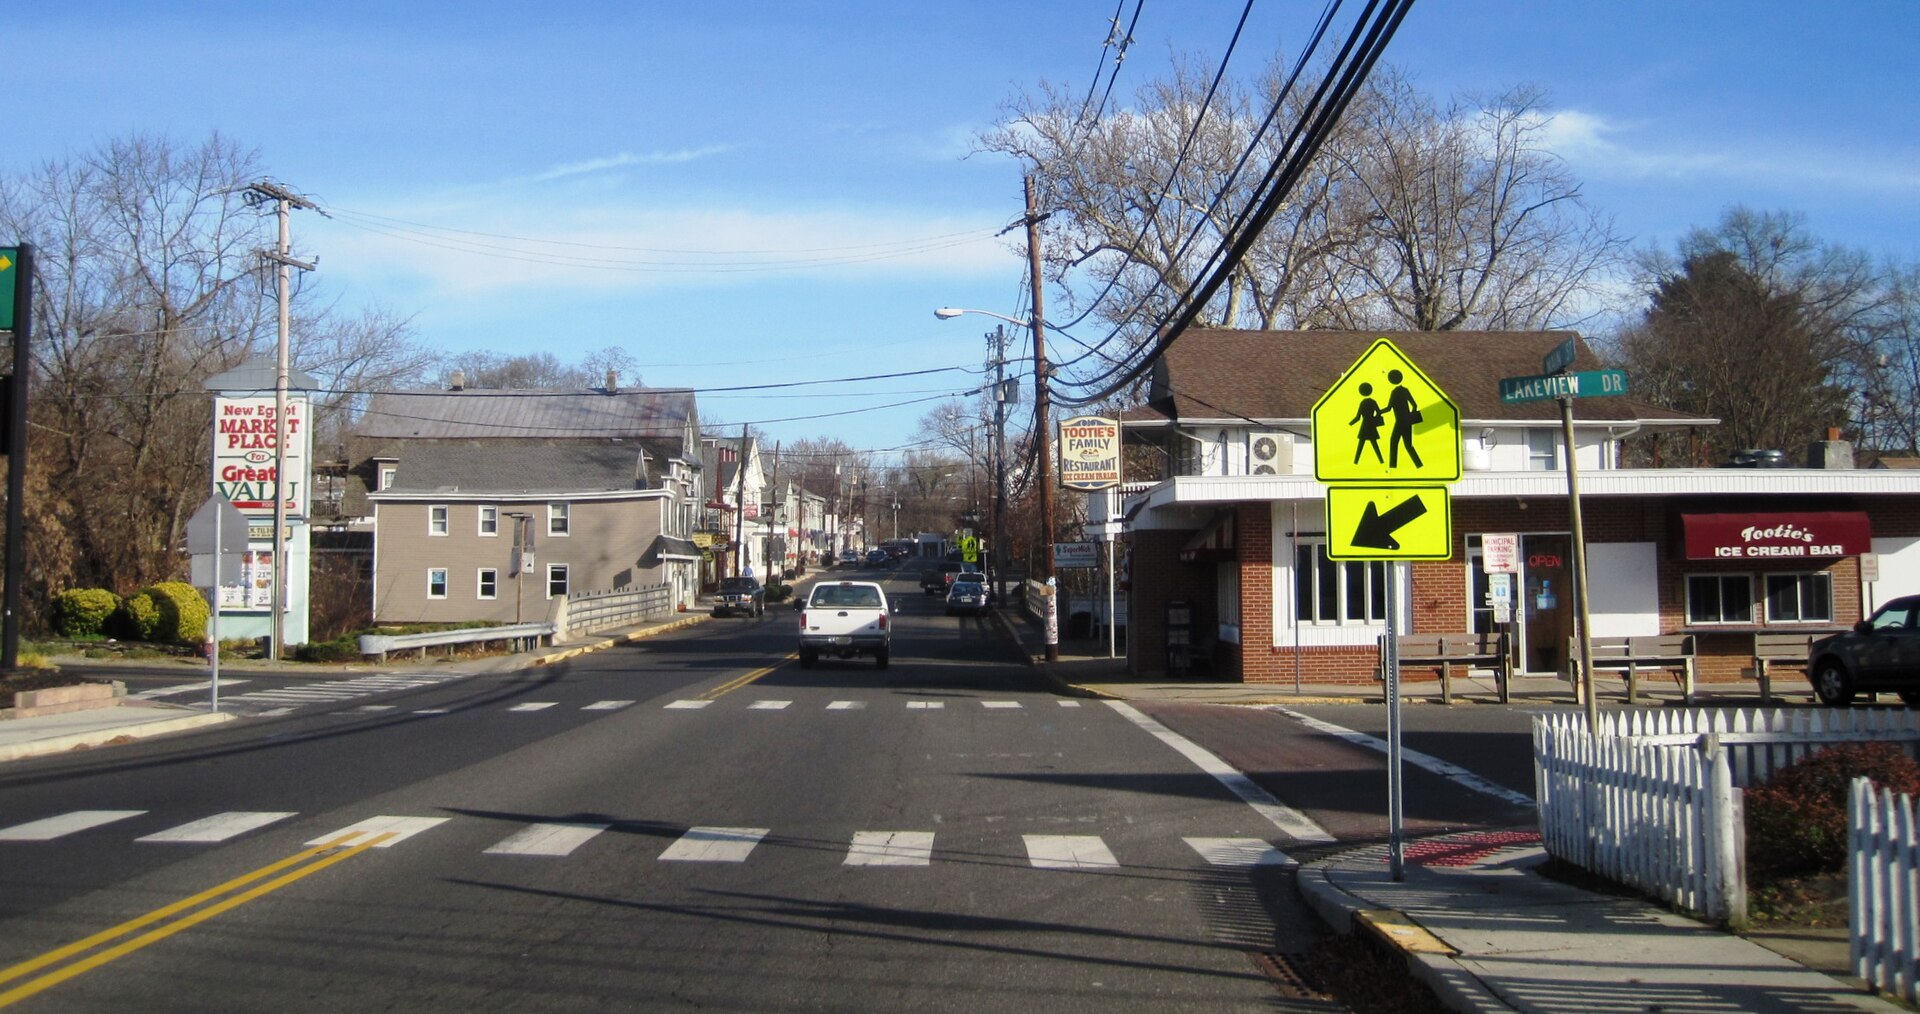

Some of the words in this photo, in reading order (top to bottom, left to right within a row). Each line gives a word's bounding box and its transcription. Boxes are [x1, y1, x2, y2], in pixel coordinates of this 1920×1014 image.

[1505, 376, 1579, 400] LAKEVIEW
[1602, 374, 1623, 392] DR
[224, 405, 254, 416] New
[219, 419, 300, 433] MARKT
[1062, 426, 1115, 438] TOOTIE'S
[228, 434, 290, 449] PLAC
[1069, 438, 1110, 451] FAMILY
[251, 453, 265, 461] For
[1063, 457, 1117, 472] RESTAURANT
[222, 465, 277, 481] Great
[1063, 473, 1073, 481] ICE
[1073, 472, 1095, 481] CREAM
[1095, 472, 1118, 480] PARLOR
[1740, 523, 1815, 543] Tootie's
[1484, 537, 1515, 546] MUNICIPAL
[1487, 545, 1512, 553] PARKING
[1715, 546, 1742, 557] ICE
[1747, 545, 1804, 556] CREAM
[1810, 544, 1843, 555] BAR
[1529, 554, 1562, 568] OPEN
